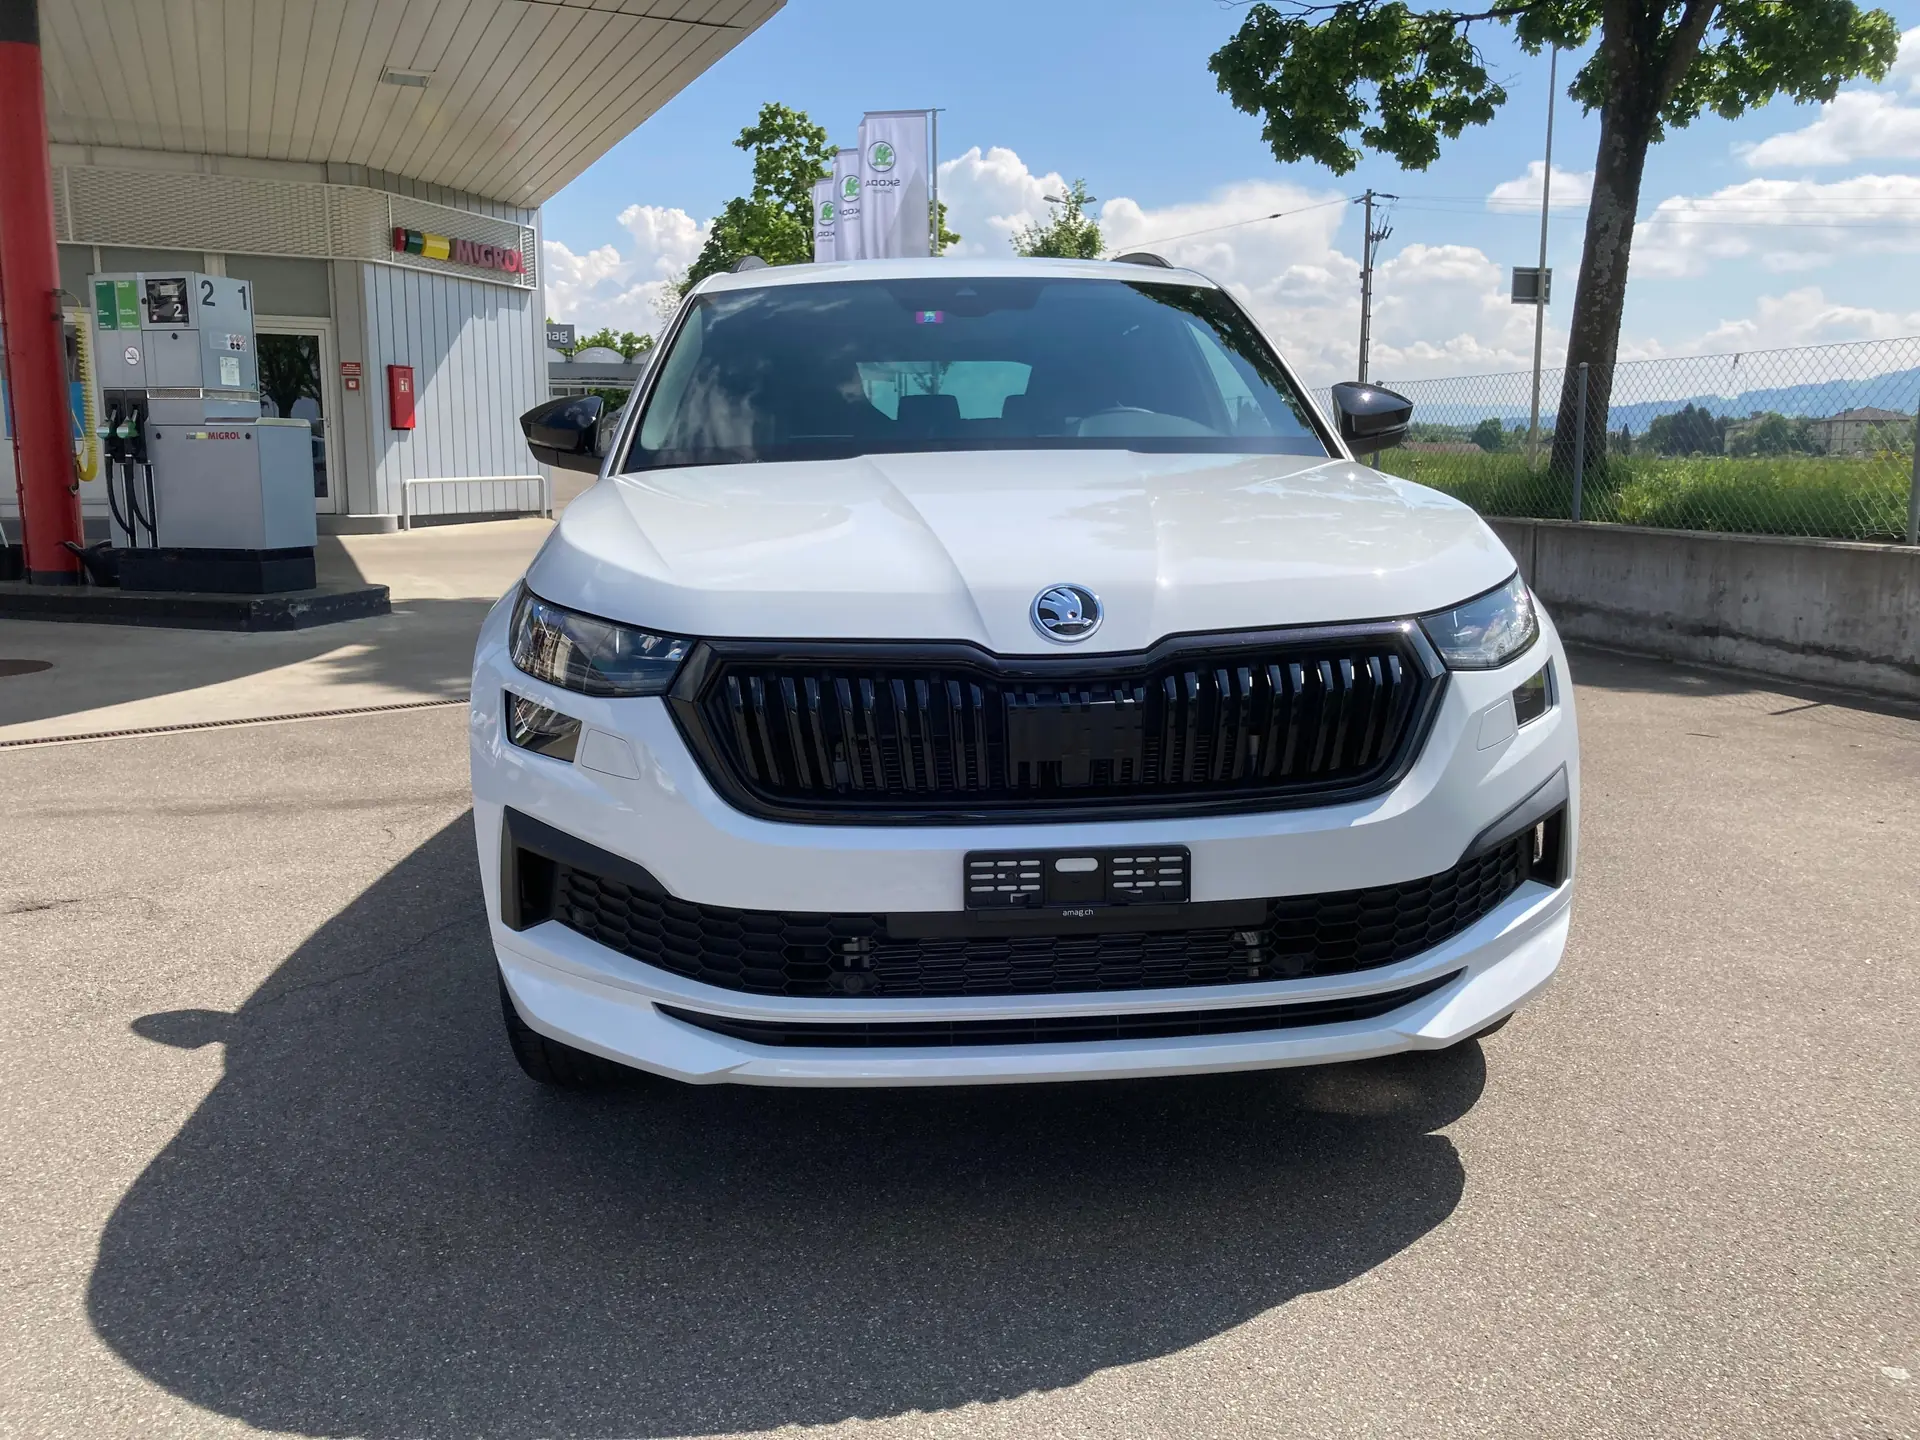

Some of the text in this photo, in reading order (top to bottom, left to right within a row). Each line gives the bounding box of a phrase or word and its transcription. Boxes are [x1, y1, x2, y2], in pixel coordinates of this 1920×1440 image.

[450, 238, 527, 274] MIGROL
[201, 280, 247, 310] 2 1
[173, 303, 183, 317] 2
[207, 432, 240, 440] MIGROL
[1062, 909, 1094, 917] amag.ch
